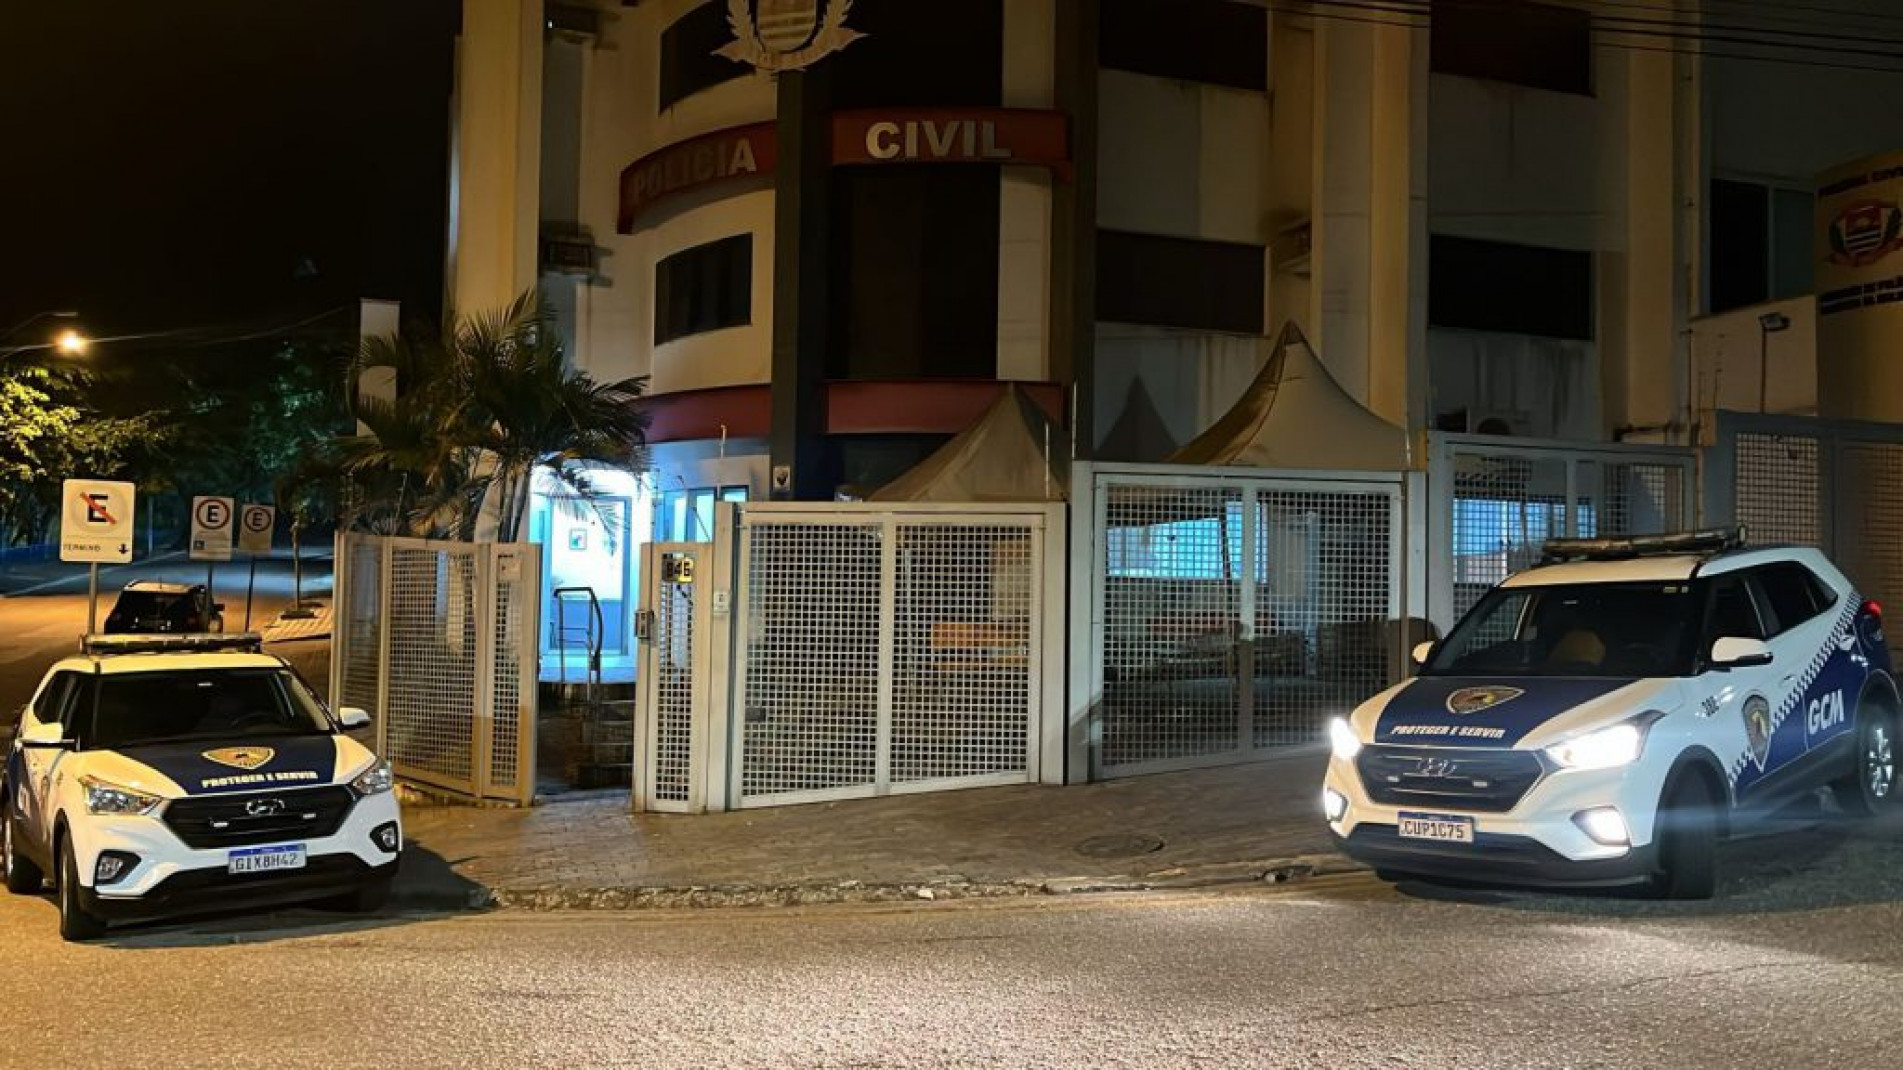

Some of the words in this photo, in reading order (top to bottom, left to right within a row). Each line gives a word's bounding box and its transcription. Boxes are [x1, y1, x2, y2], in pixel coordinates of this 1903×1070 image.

[865, 120, 1012, 160] CIVIL
[87, 494, 109, 523] E
[206, 504, 221, 523] E
[252, 511, 264, 527] E
[1807, 688, 1846, 736] GCM
[1390, 725, 1451, 736] PROTEGER
[1449, 725, 1460, 736] E
[1458, 726, 1507, 739] SERVIR
[201, 774, 266, 789] PROTEGER
[274, 770, 319, 782] SERVIR
[1403, 820, 1465, 839] CUP1C75
